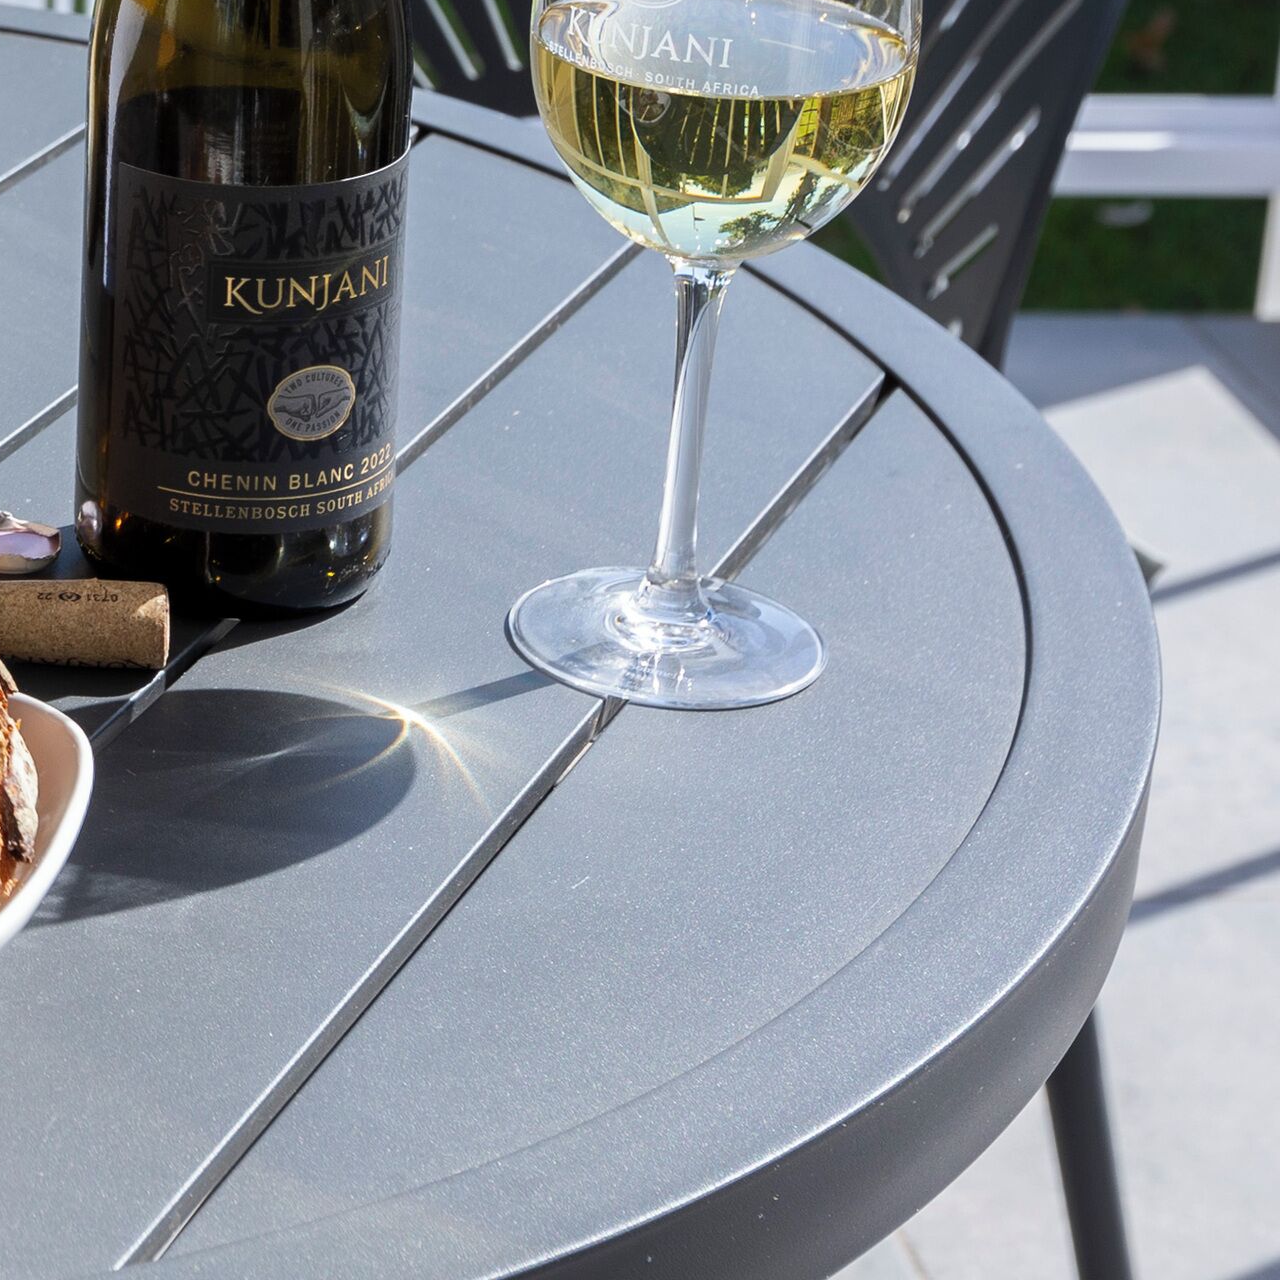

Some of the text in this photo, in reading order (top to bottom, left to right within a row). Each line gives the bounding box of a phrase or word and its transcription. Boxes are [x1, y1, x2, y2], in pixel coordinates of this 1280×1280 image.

[568, 5, 733, 69] KUNJANI
[645, 72, 696, 90] SOUTH
[702, 81, 760, 97] AFRICA
[223, 255, 389, 314] KUNJANI
[284, 372, 343, 394] TWO CULTURES
[285, 410, 340, 432] ONE PASSION
[188, 443, 391, 492] CHENIN BLANC 2022
[169, 498, 311, 520] STELLENBOSCH
[316, 491, 363, 514] SOUTH
[37, 592, 52, 601] 22
